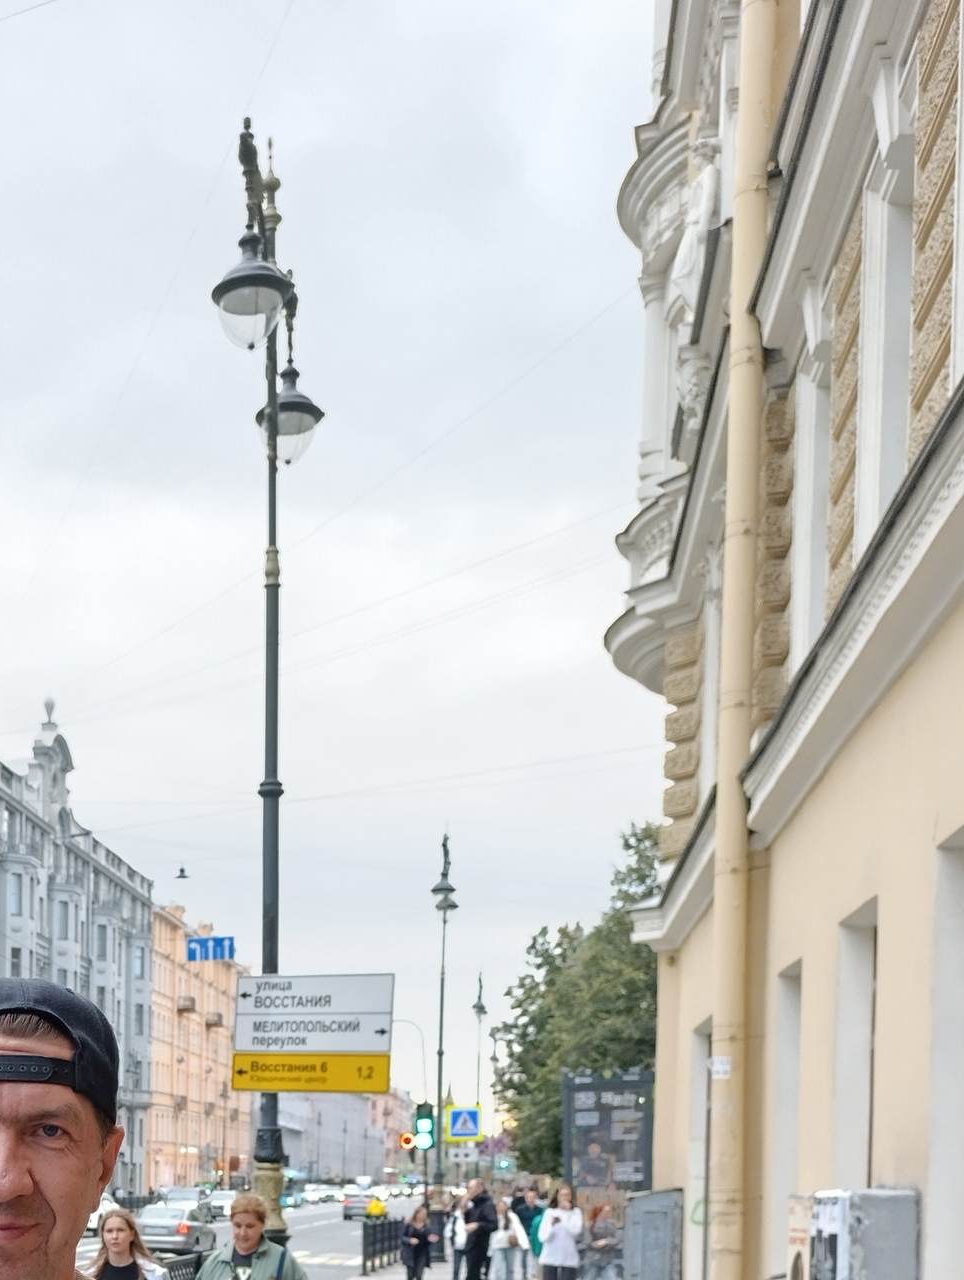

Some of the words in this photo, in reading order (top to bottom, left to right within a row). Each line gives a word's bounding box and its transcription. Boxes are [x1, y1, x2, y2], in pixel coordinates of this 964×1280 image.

[255, 980, 292, 992] улица
[254, 994, 331, 1009] ВОССТАНИЯ
[252, 1018, 360, 1033] МЕЛИТОПОЛЬСКИЙ
[252, 1035, 307, 1049] переулок
[250, 1060, 317, 1073] Восстания
[320, 1061, 328, 1074] 6
[356, 1066, 374, 1081] 1,2
[304, 1075, 327, 1084] центр
